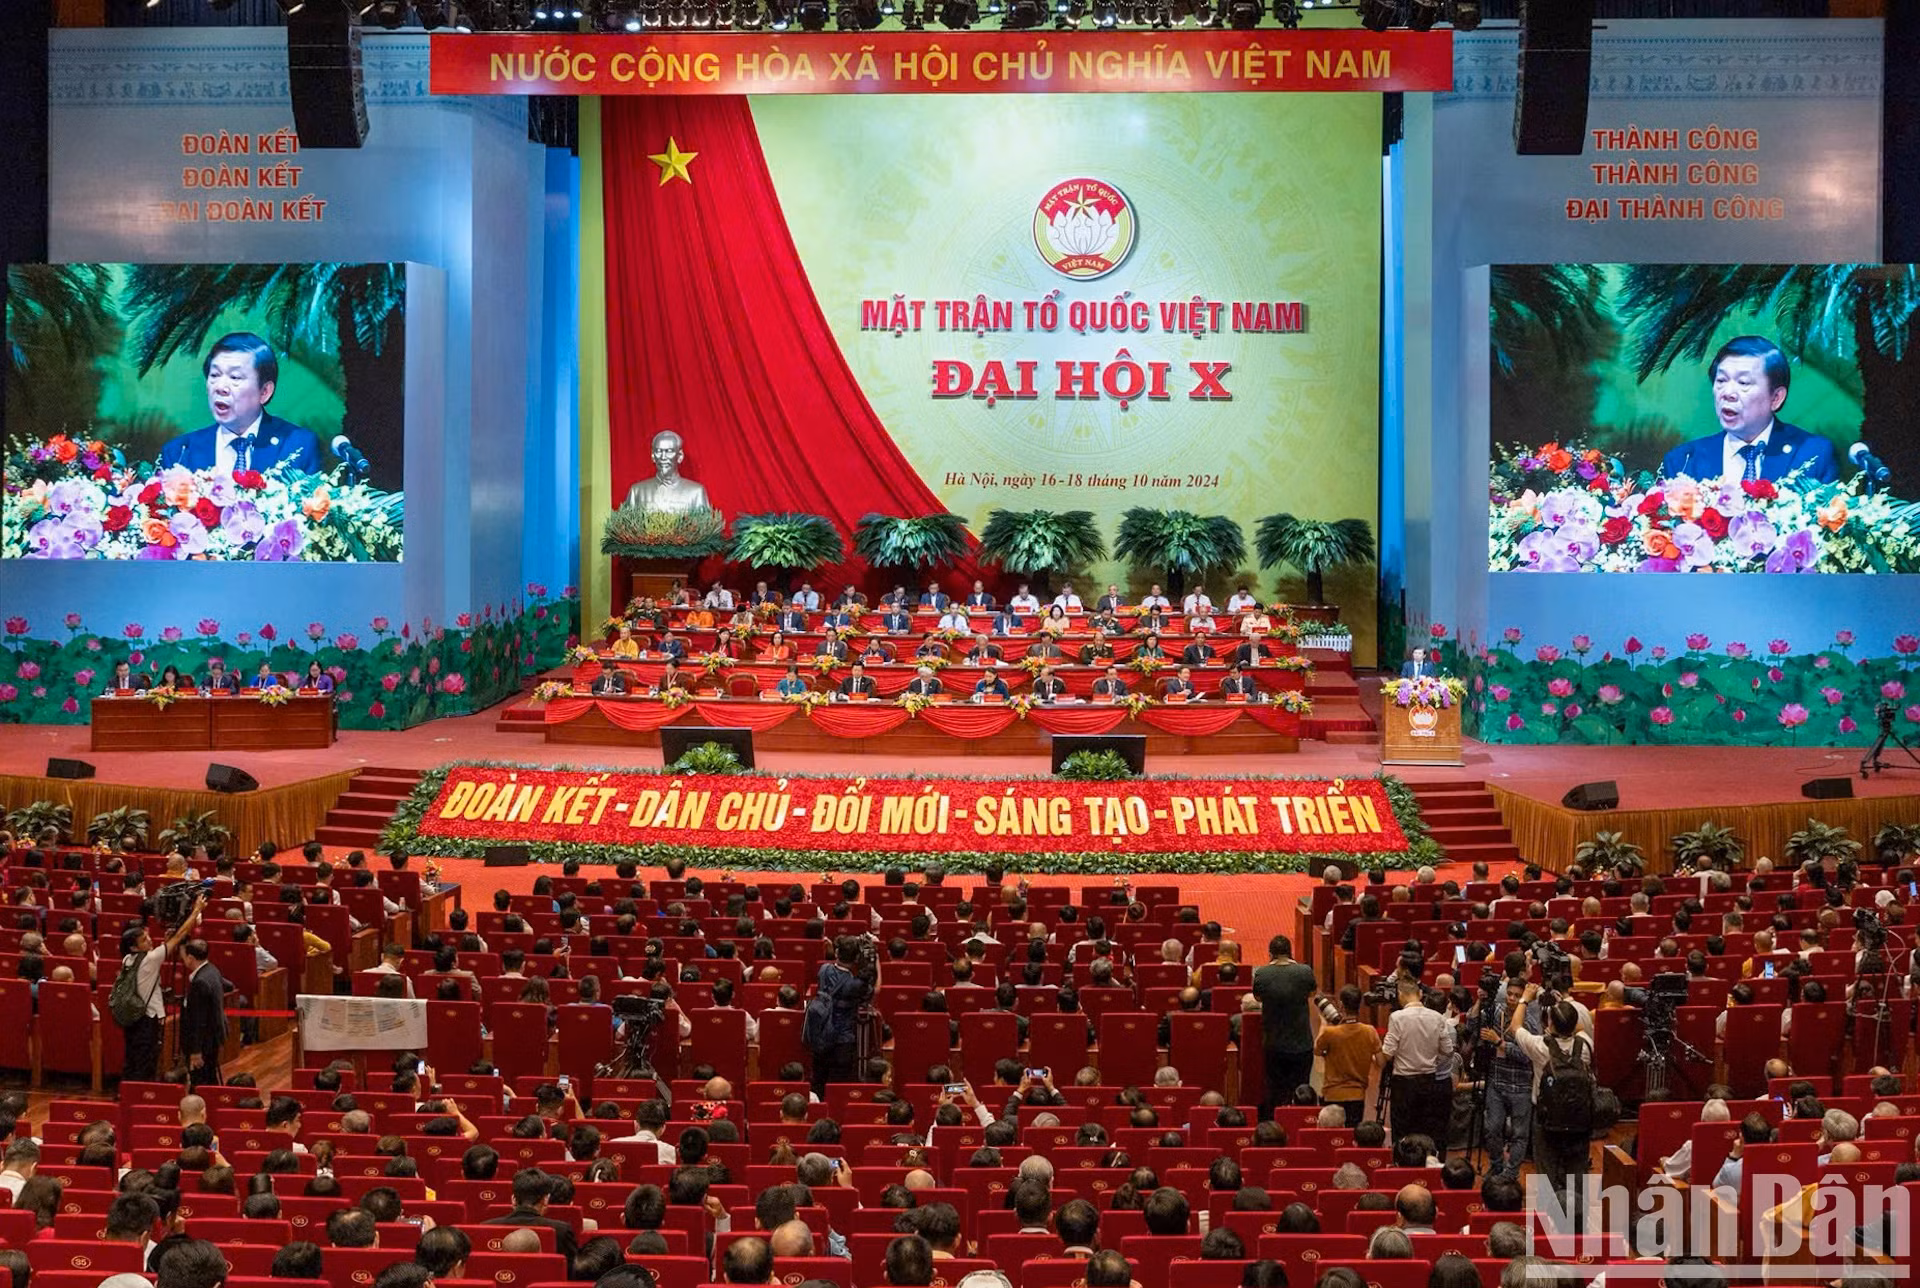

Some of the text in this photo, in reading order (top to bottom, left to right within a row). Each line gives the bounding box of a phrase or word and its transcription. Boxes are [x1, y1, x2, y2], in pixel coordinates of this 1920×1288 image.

[489, 39, 1392, 87] NƯỚC CỘNG HÒA XÃ HỘI CHỦ NGHĨA VIỆT NAM
[183, 129, 249, 154] ĐOÀN
[1591, 123, 1759, 150] THÀNH CÔNG
[183, 161, 302, 188] ĐOÀN KẾT
[1591, 160, 1759, 185] THÀNH CÔNG
[206, 198, 273, 222] ĐOÀN
[282, 195, 326, 222] KẾT
[1566, 194, 1784, 224] ĐẠI THÀNH CÔNG
[1084, 258, 1105, 270] NAM
[861, 289, 1304, 338] MẶT TRẬN TỔ QUỐC VIỆT NAM
[932, 347, 1232, 410] ĐẠI HỘI X
[944, 472, 1219, 492] Hà Nội, ngày 16-18 tháng 10 năm 2024
[440, 774, 546, 822] ĐOÀN
[541, 773, 617, 826] KẾT
[629, 780, 711, 831] DÂN
[716, 779, 790, 832] CHỦ
[811, 778, 869, 834] ĐỔI
[879, 785, 949, 835] MỚI
[973, 788, 1071, 836] SÁNG
[1084, 797, 1149, 844] TẠO
[1173, 786, 1259, 836] PHÁT
[1272, 778, 1382, 834] TRIỂN
[75, 1258, 87, 1267] 35
[355, 1272, 368, 1281] 33
[787, 1275, 800, 1284] 30
